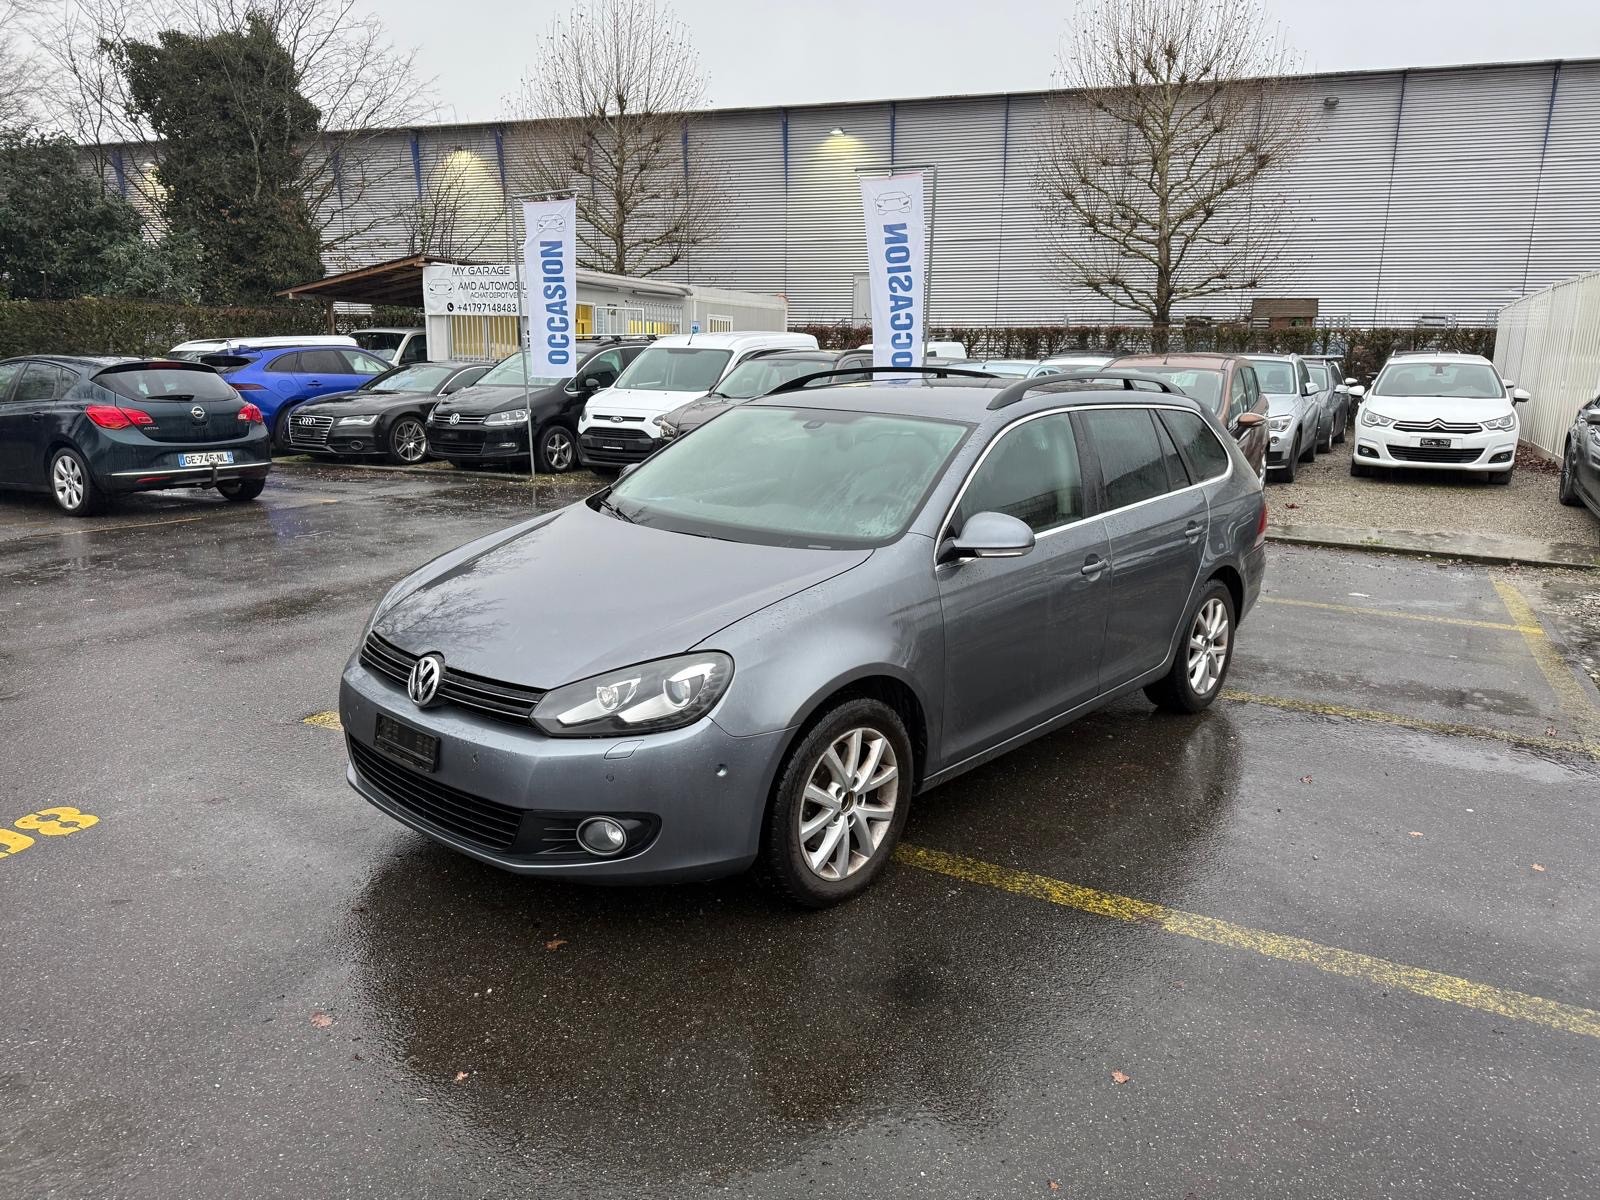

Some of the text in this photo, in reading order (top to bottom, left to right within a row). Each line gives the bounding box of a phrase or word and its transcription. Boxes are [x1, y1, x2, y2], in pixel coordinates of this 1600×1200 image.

[452, 266, 511, 275] MY GARAGE
[458, 281, 477, 291] AMD
[457, 302, 517, 313] +41797148483
[540, 240, 570, 365] OCCASION
